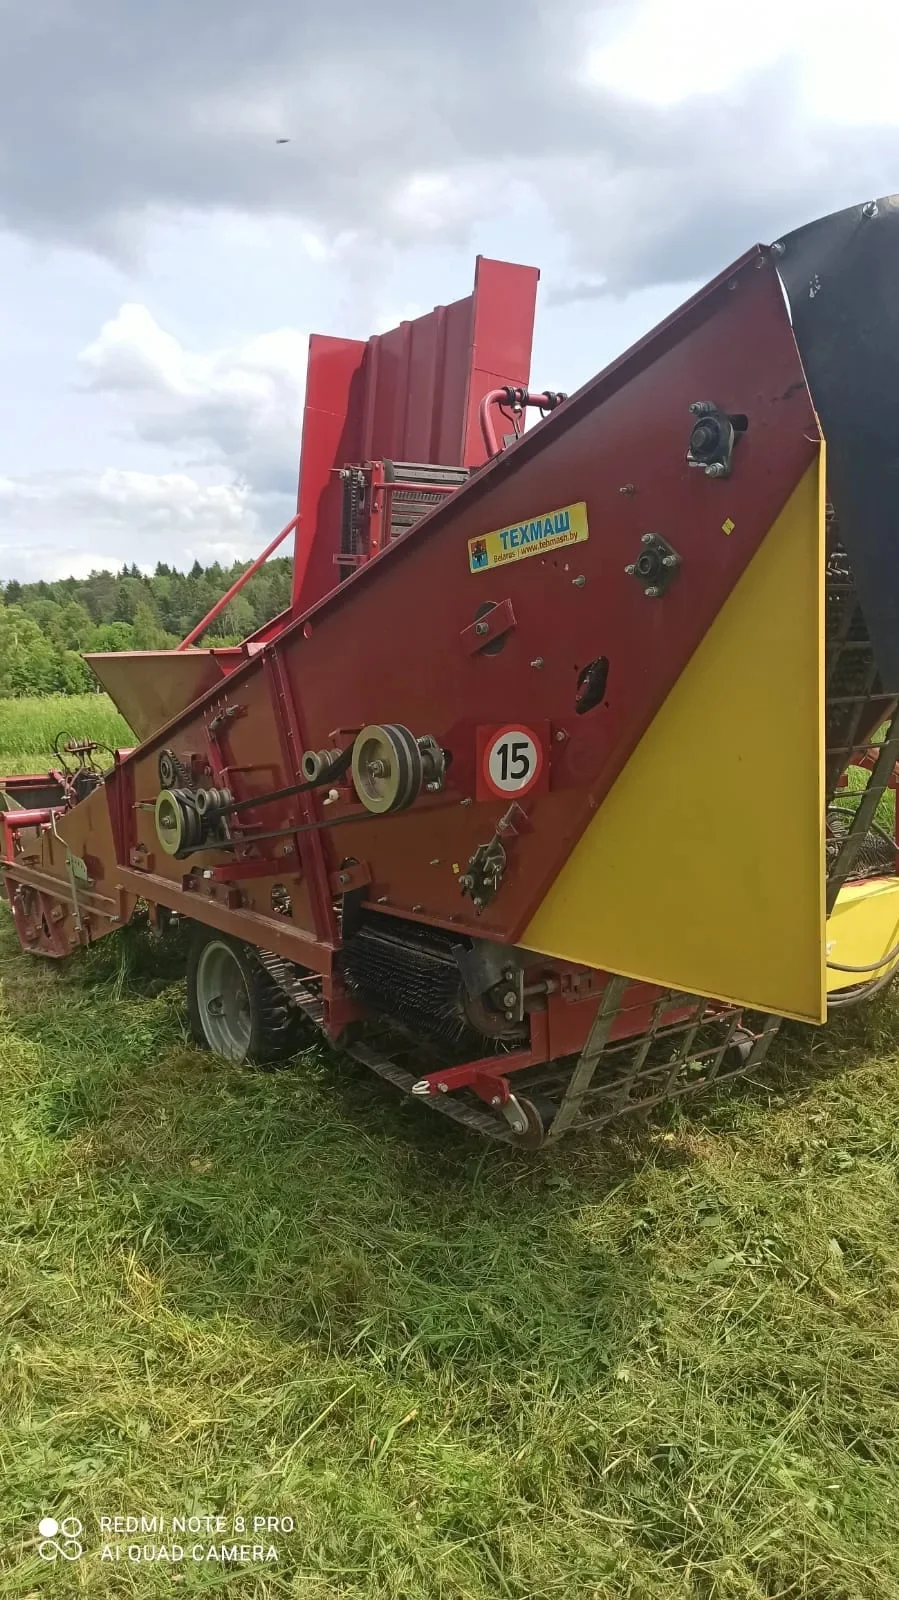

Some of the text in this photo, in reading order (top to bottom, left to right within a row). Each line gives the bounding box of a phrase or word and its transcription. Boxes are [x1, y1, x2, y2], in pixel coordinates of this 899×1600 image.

[493, 531, 578, 563] Belarus www.tehmash.by
[500, 511, 570, 550] ТЕХМАШ
[497, 742, 530, 780] 15
